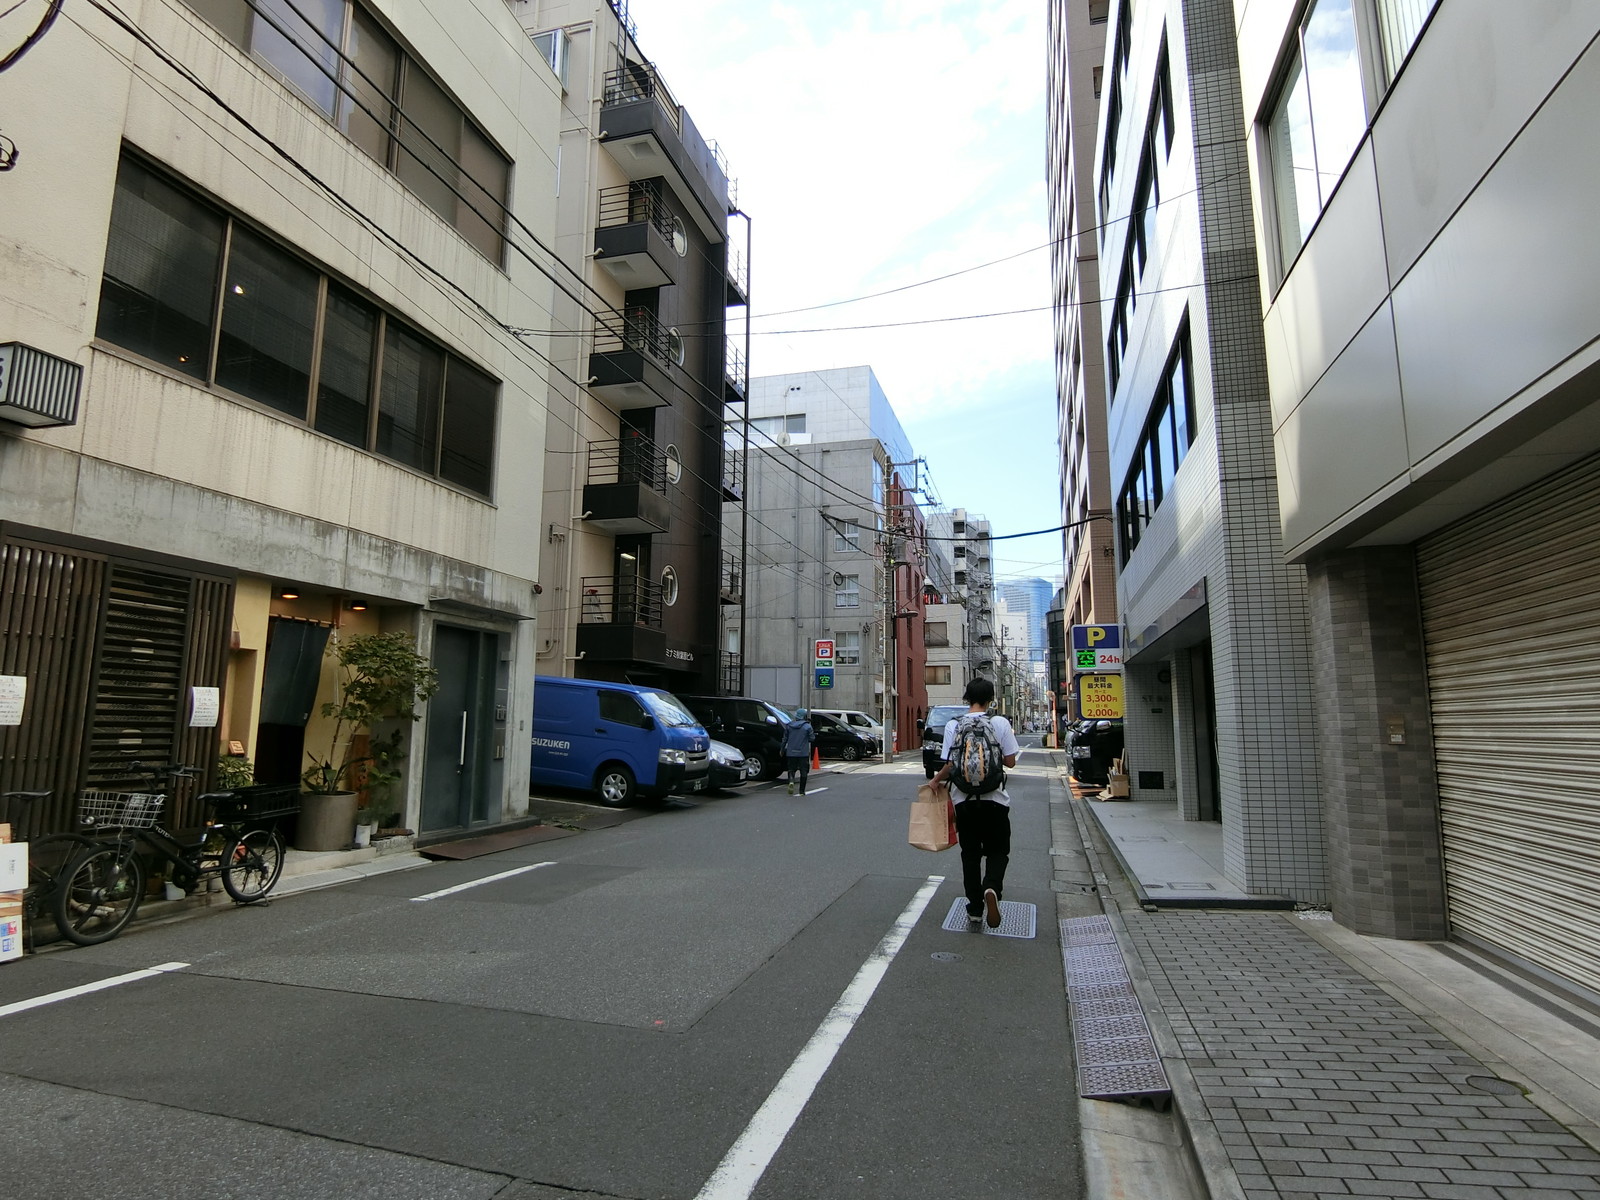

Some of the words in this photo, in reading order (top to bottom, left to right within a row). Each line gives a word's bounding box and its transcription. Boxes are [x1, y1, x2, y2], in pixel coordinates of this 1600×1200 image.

[1087, 627, 1106, 647] P
[1076, 650, 1096, 668] 空
[1100, 654, 1120, 663] 24h
[819, 675, 830, 686] 空
[531, 737, 570, 750] SUZUKEN
